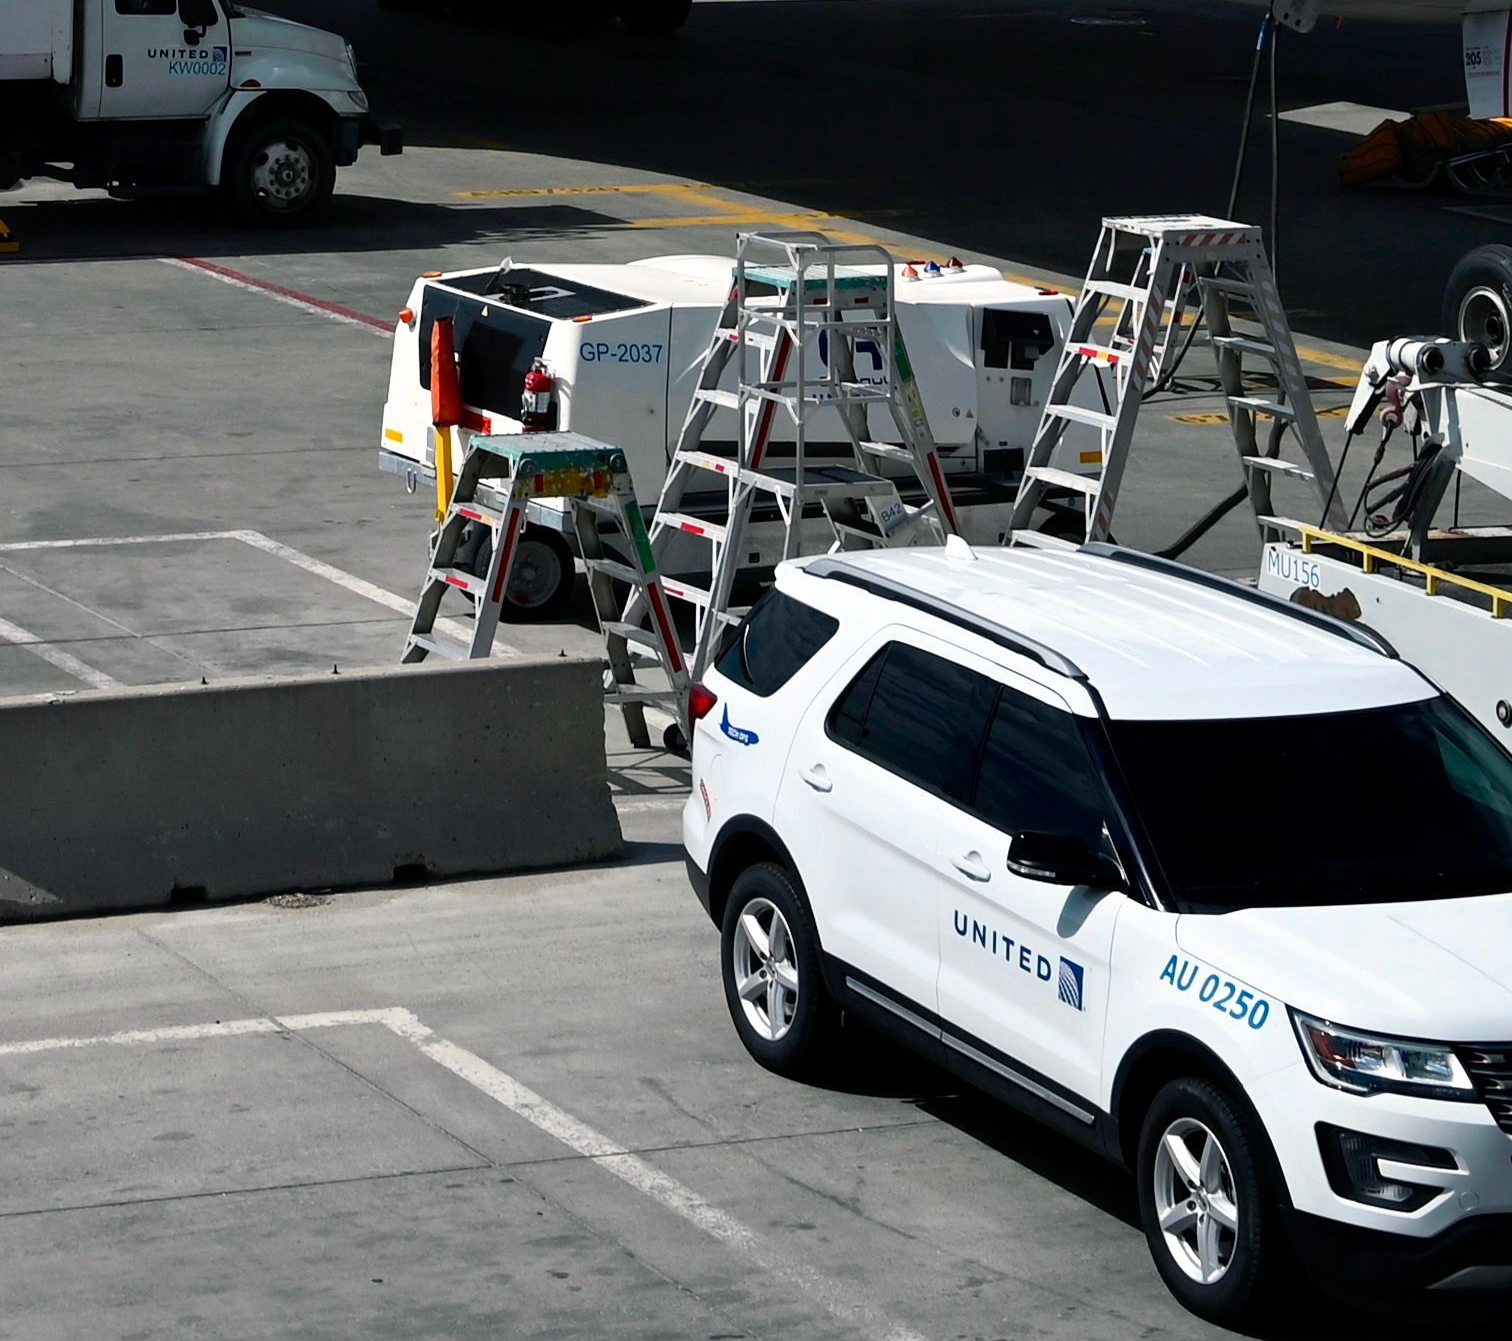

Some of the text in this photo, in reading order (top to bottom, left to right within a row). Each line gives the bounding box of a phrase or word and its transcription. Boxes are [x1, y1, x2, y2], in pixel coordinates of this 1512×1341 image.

[147, 48, 209, 59] UNITED
[168, 60, 226, 76] KW0002
[579, 342, 663, 363] GP-2037
[1268, 550, 1320, 588] MU156
[954, 909, 1051, 981] UNITED
[1159, 954, 1270, 1029] AU 0250
